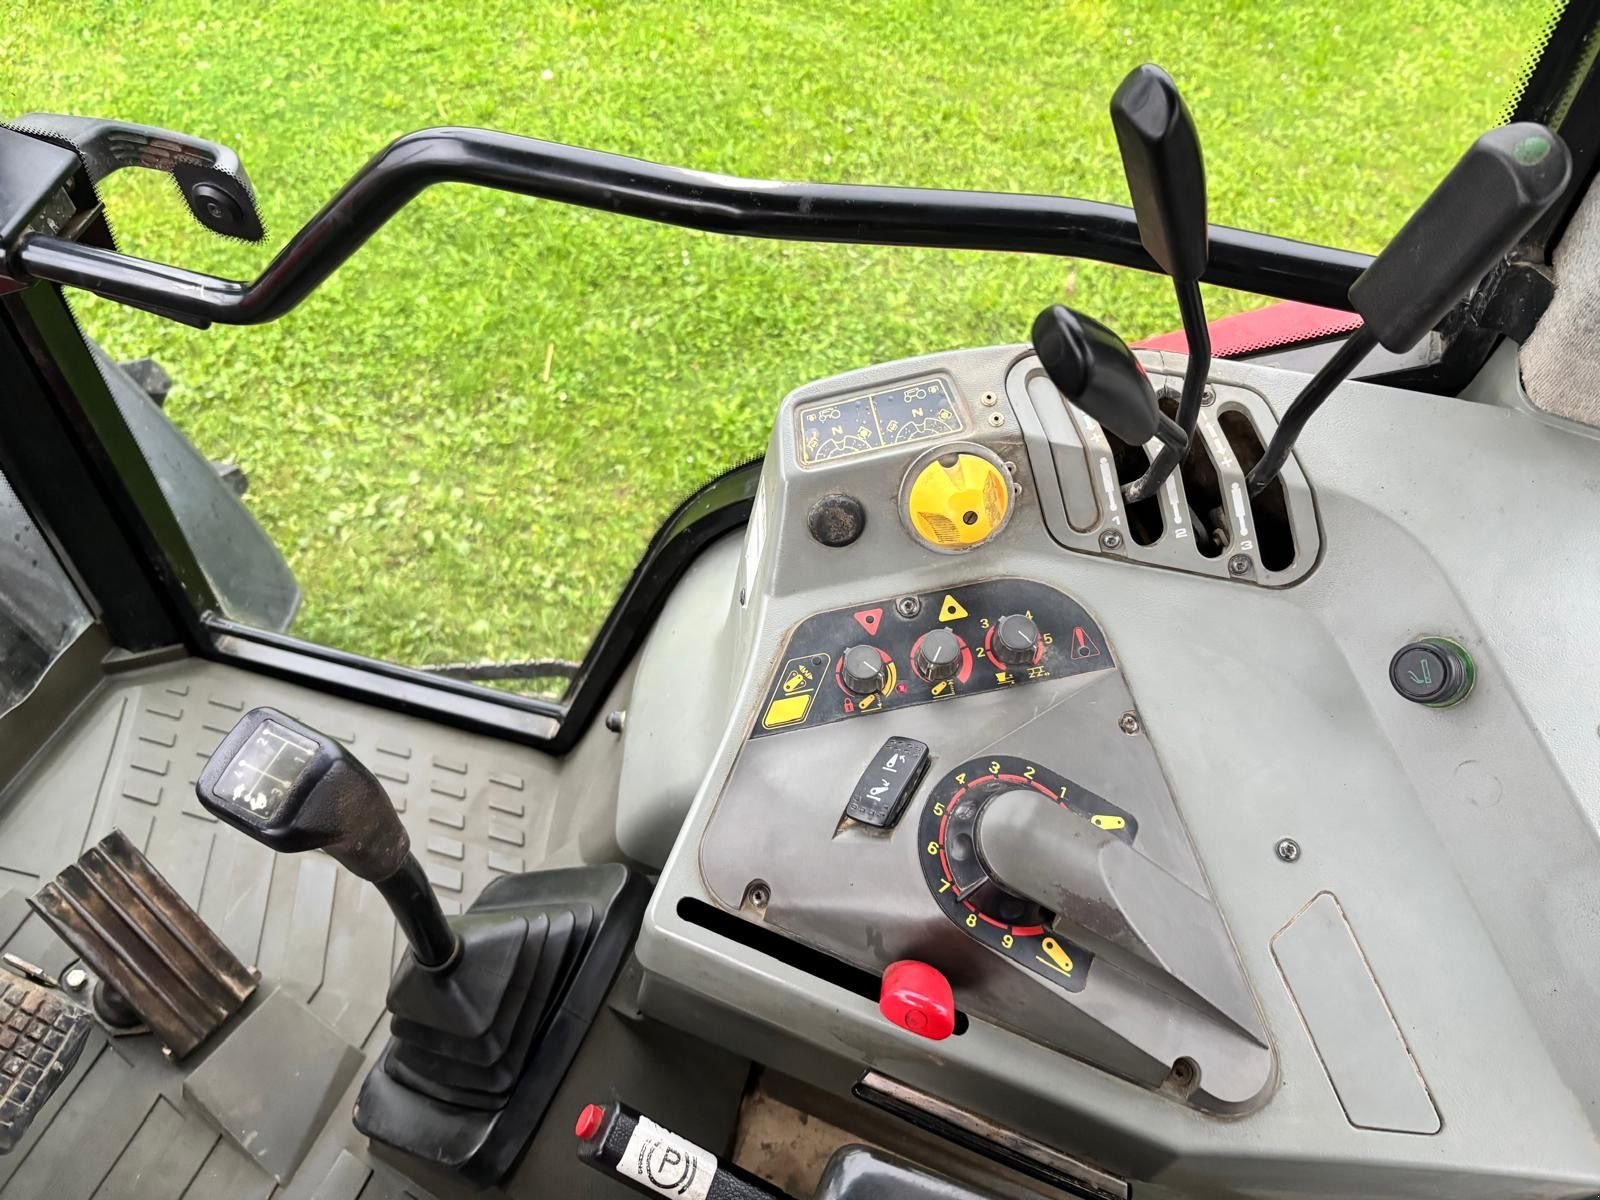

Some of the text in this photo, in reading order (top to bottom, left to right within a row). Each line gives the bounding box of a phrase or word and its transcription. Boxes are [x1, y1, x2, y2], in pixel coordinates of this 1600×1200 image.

[911, 407, 923, 418] N
[831, 425, 843, 435] N
[1111, 515, 1121, 526] 1
[1174, 528, 1188, 539] 2
[1240, 540, 1253, 550] 3
[980, 618, 990, 629] 3
[1043, 633, 1053, 644] 5
[976, 647, 986, 658] 2
[988, 761, 1001, 774] 3
[1024, 766, 1035, 779] 2
[955, 773, 967, 785] 4
[1060, 786, 1067, 799] 1
[933, 802, 945, 816] 5
[927, 842, 939, 855] 6
[938, 878, 950, 893] 7
[965, 913, 977, 928] 8
[1002, 934, 1014, 949] 9
[658, 1146, 681, 1173] P
